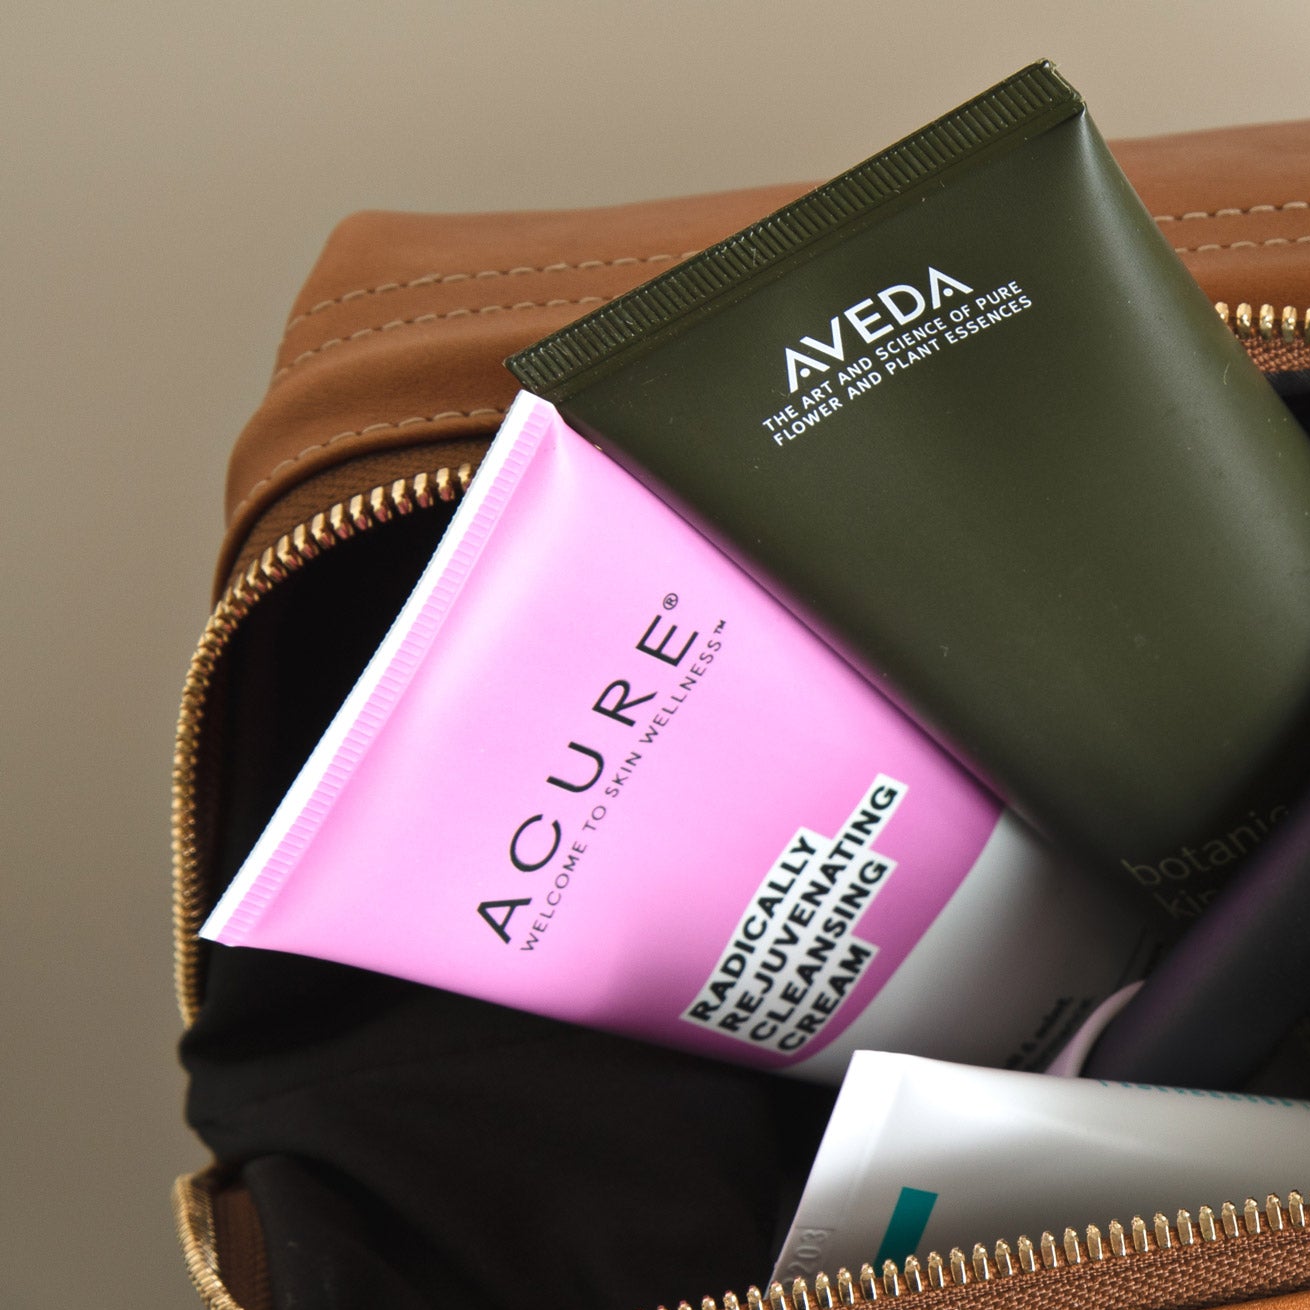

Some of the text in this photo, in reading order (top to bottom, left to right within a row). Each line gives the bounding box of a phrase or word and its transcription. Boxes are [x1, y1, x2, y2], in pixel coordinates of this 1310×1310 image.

[761, 280, 1023, 432] THE ART AND SCIENCE OF PURE
[772, 295, 1033, 447] FLOWER AND PLANT ESSENCES
[785, 266, 974, 394] AVEDA
[520, 840, 587, 952] WELCOME
[582, 805, 608, 832] TO
[604, 751, 642, 798] SKIN
[688, 836, 818, 1023] RADICALLY
[717, 784, 898, 1034] REJUVENATING
[748, 860, 889, 1043] CLEANSING
[778, 944, 872, 1052] CREAM
